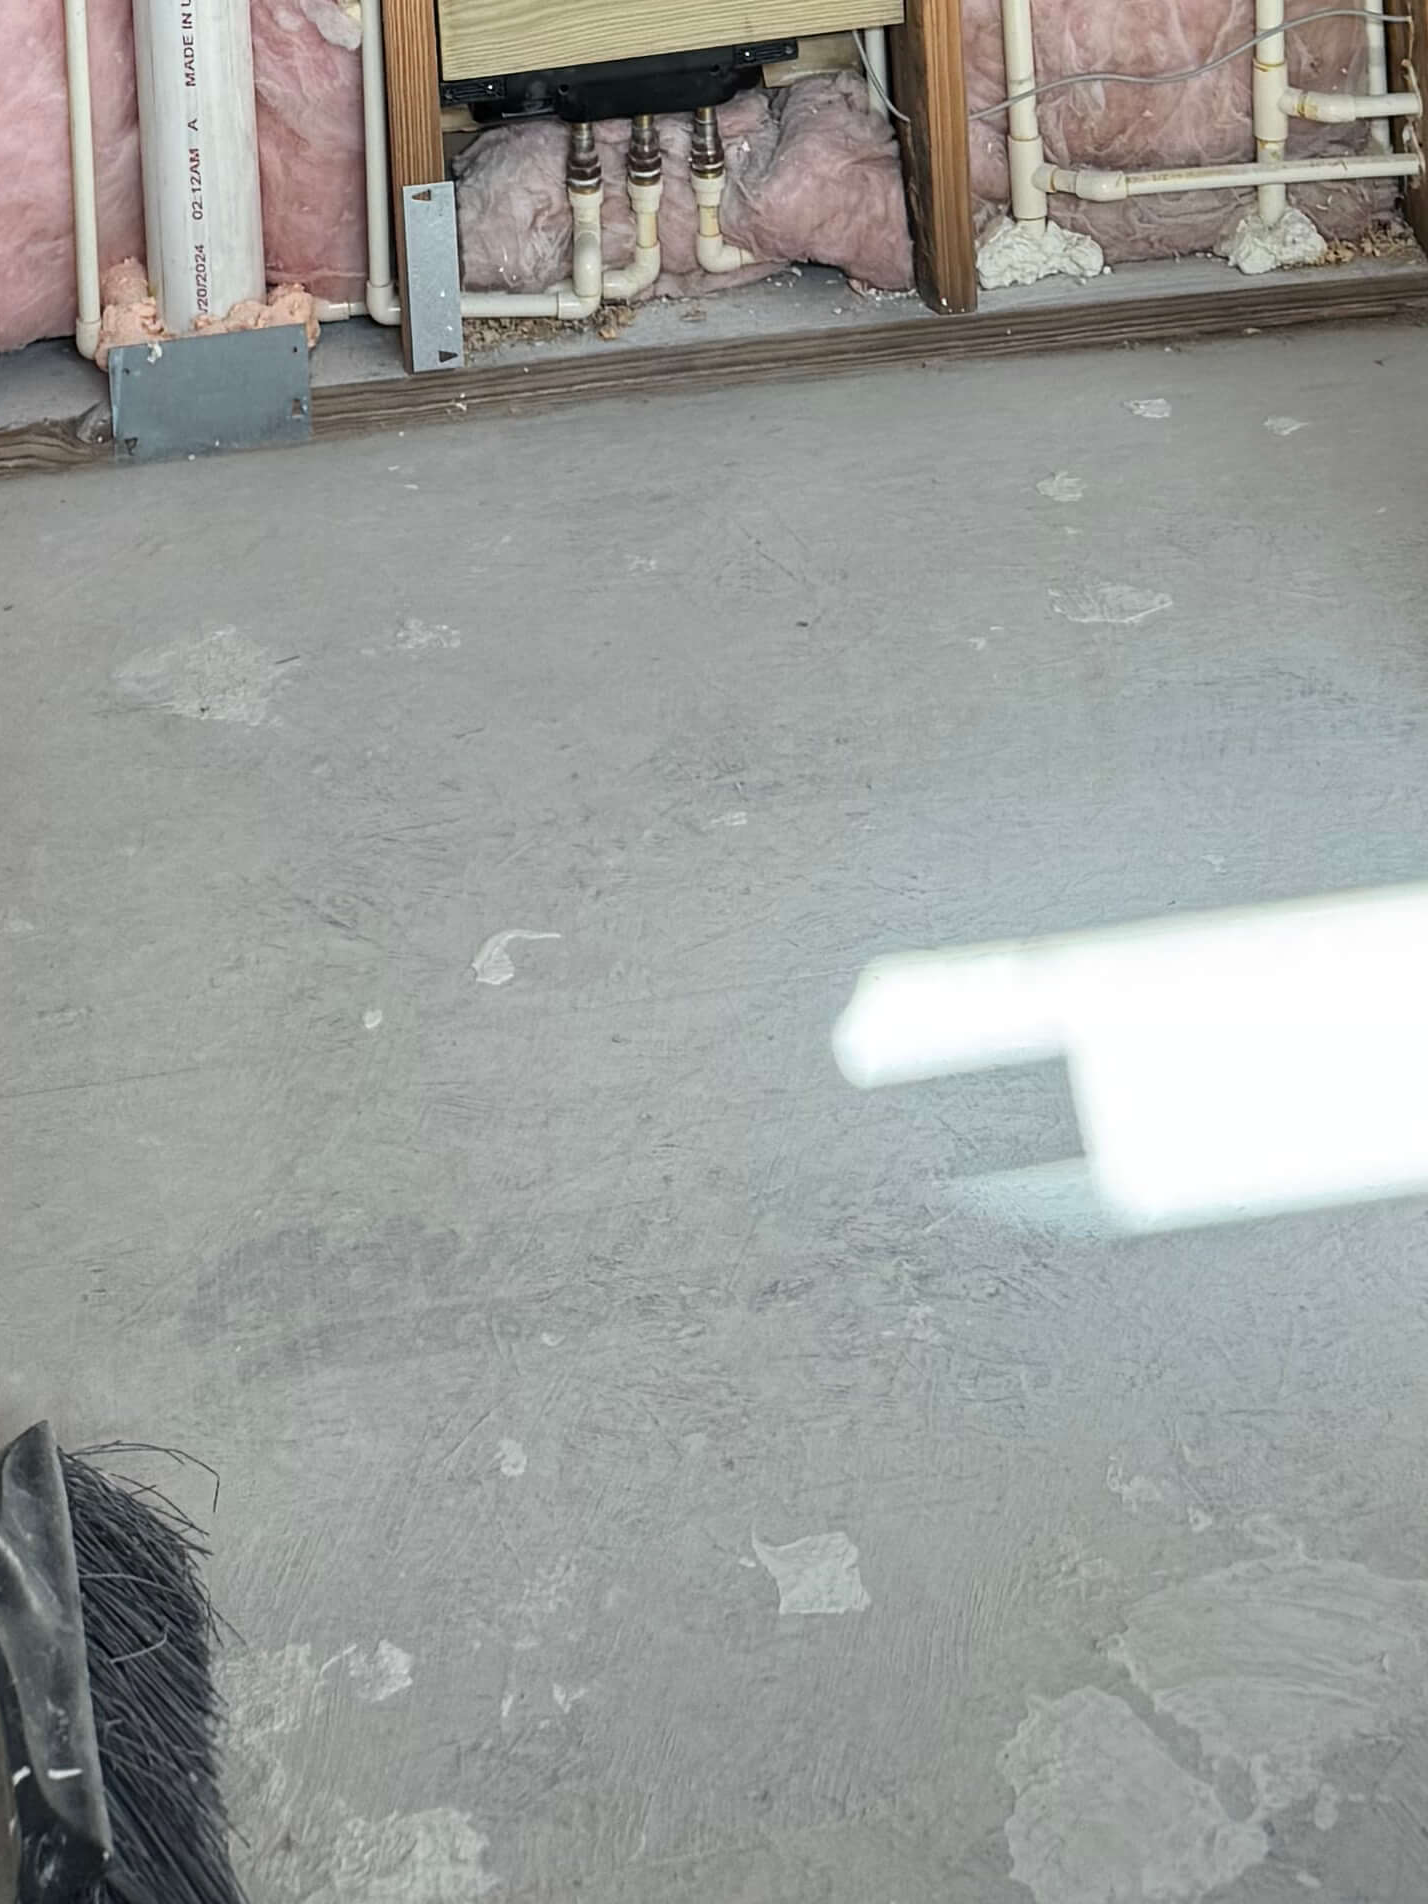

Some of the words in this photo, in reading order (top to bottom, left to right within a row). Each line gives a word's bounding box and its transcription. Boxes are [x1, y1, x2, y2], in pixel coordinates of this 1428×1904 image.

[181, 12, 193, 29] IN
[182, 35, 196, 87] MADE
[186, 118, 199, 131] A
